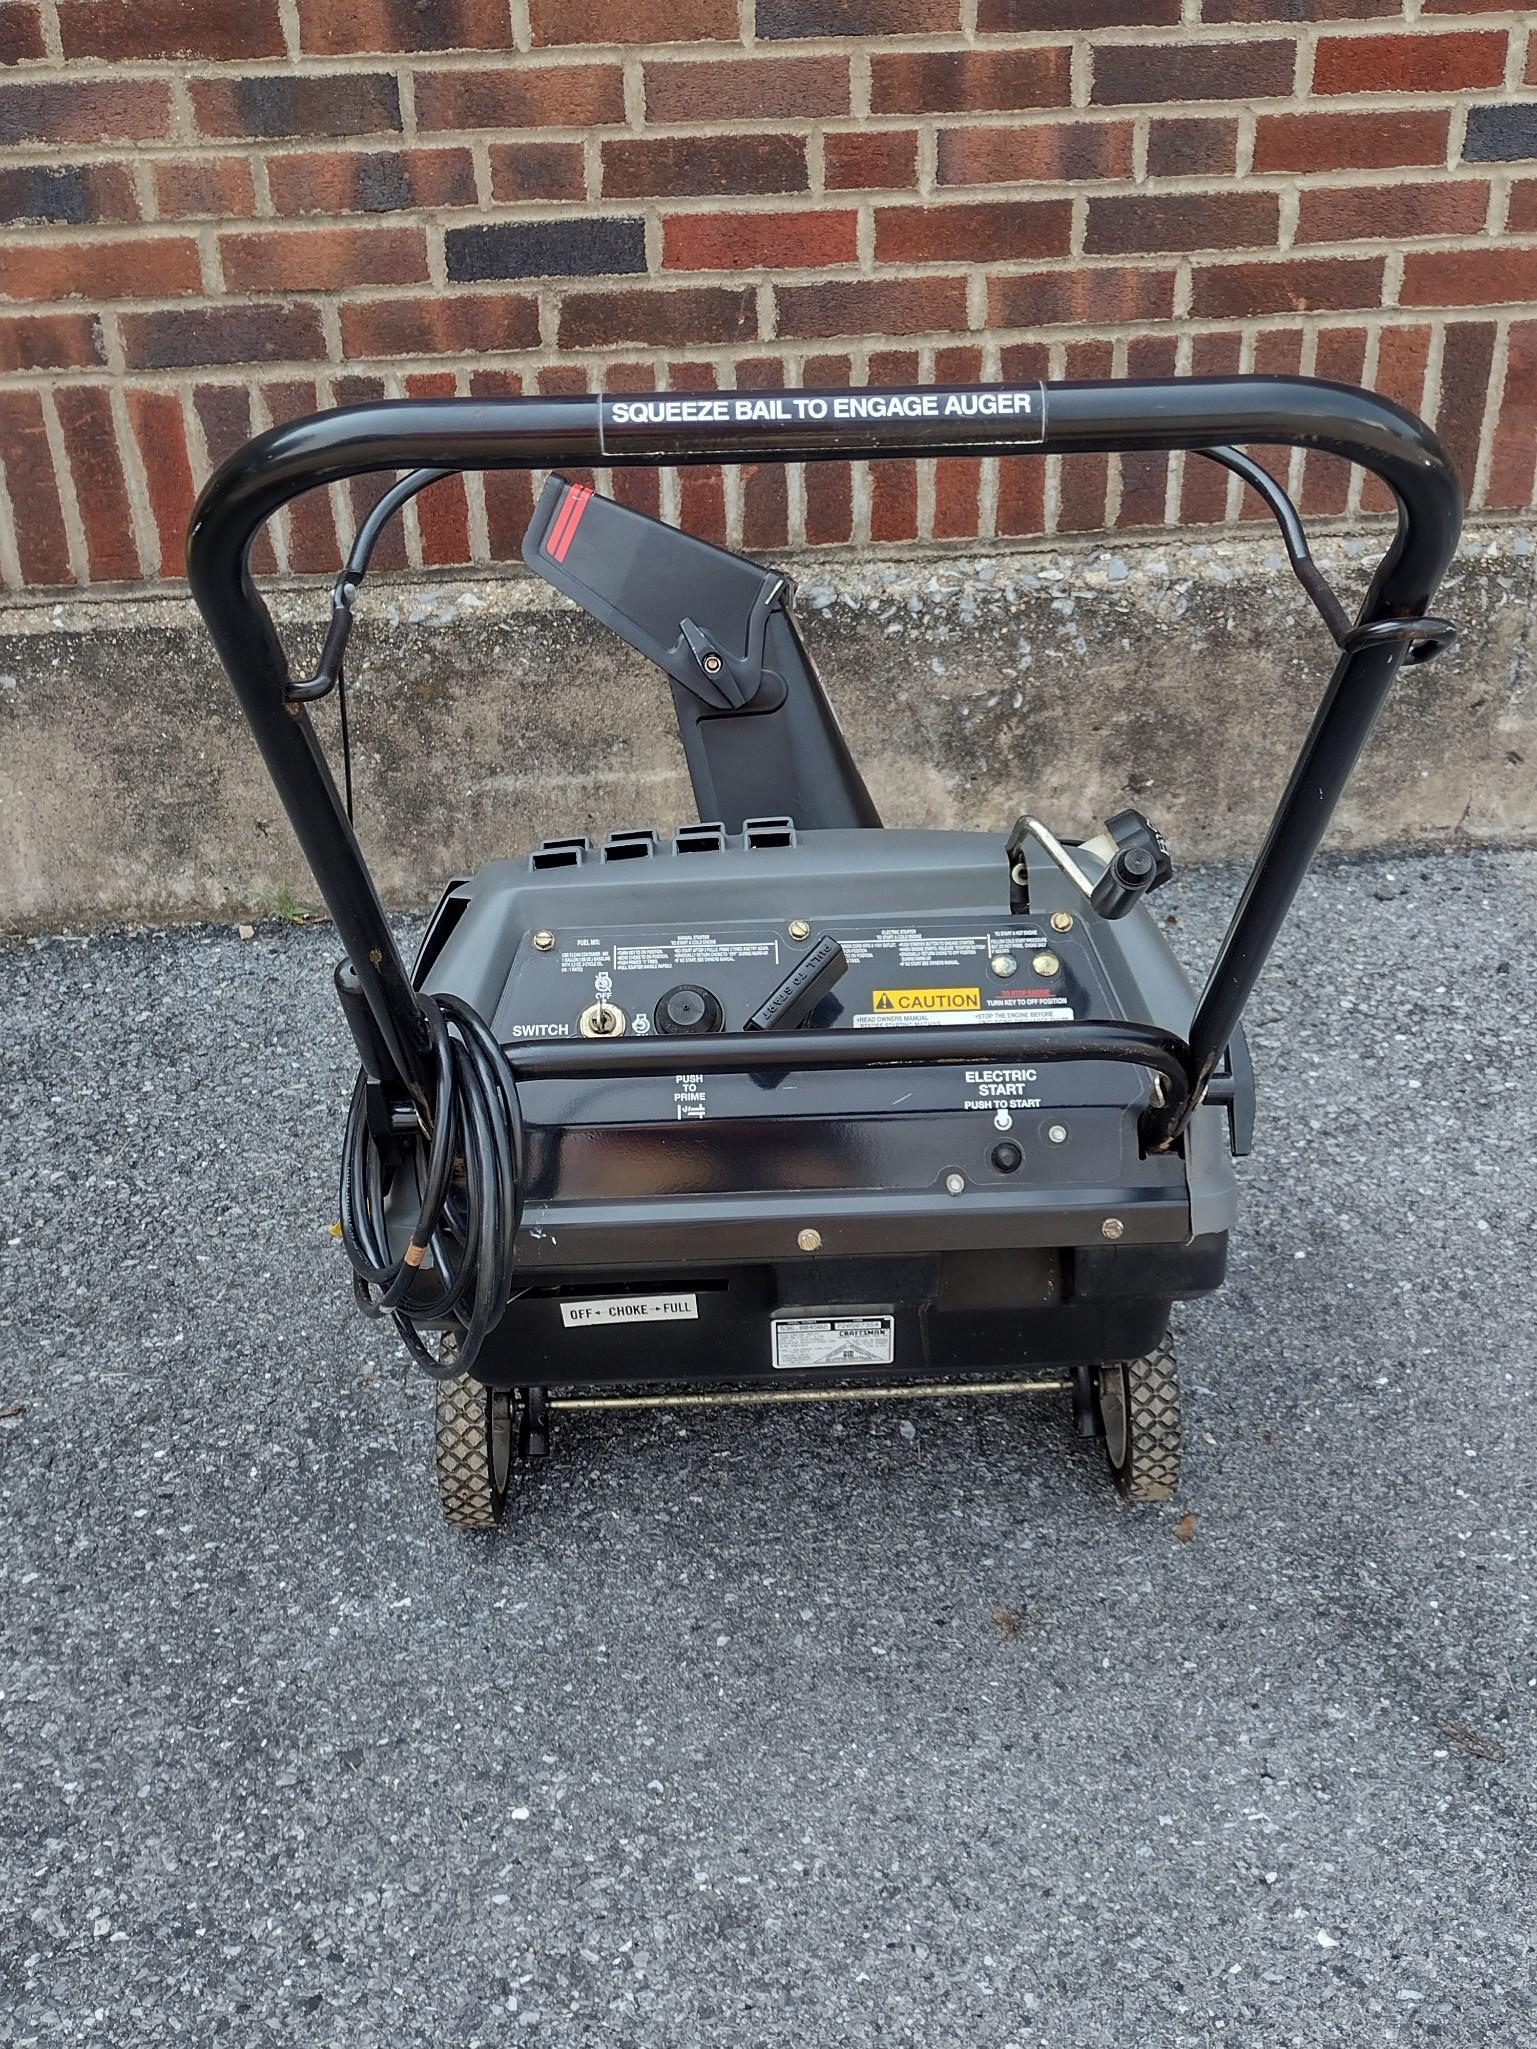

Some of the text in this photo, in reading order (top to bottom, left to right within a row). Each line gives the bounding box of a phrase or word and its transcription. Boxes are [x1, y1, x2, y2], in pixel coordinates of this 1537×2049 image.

[612, 393, 1030, 423] SQUEEZE BAIL TO ENGAGE AUGER
[762, 944, 832, 1020] PULL TO START
[595, 992, 612, 1000] OFF
[898, 994, 978, 1009] CAUTION
[512, 1024, 569, 1037] SWITCH
[675, 1074, 704, 1084] PUSH
[965, 1069, 1037, 1083] ELECTRIC
[682, 1083, 697, 1093] TO
[979, 1083, 1025, 1096] START
[674, 1092, 706, 1102] PRIME
[964, 1099, 1041, 1110] PUSH TO START
[570, 1302, 692, 1320] OFF CHOKE FULL
[839, 1329, 885, 1337] CRAFTSMAN
